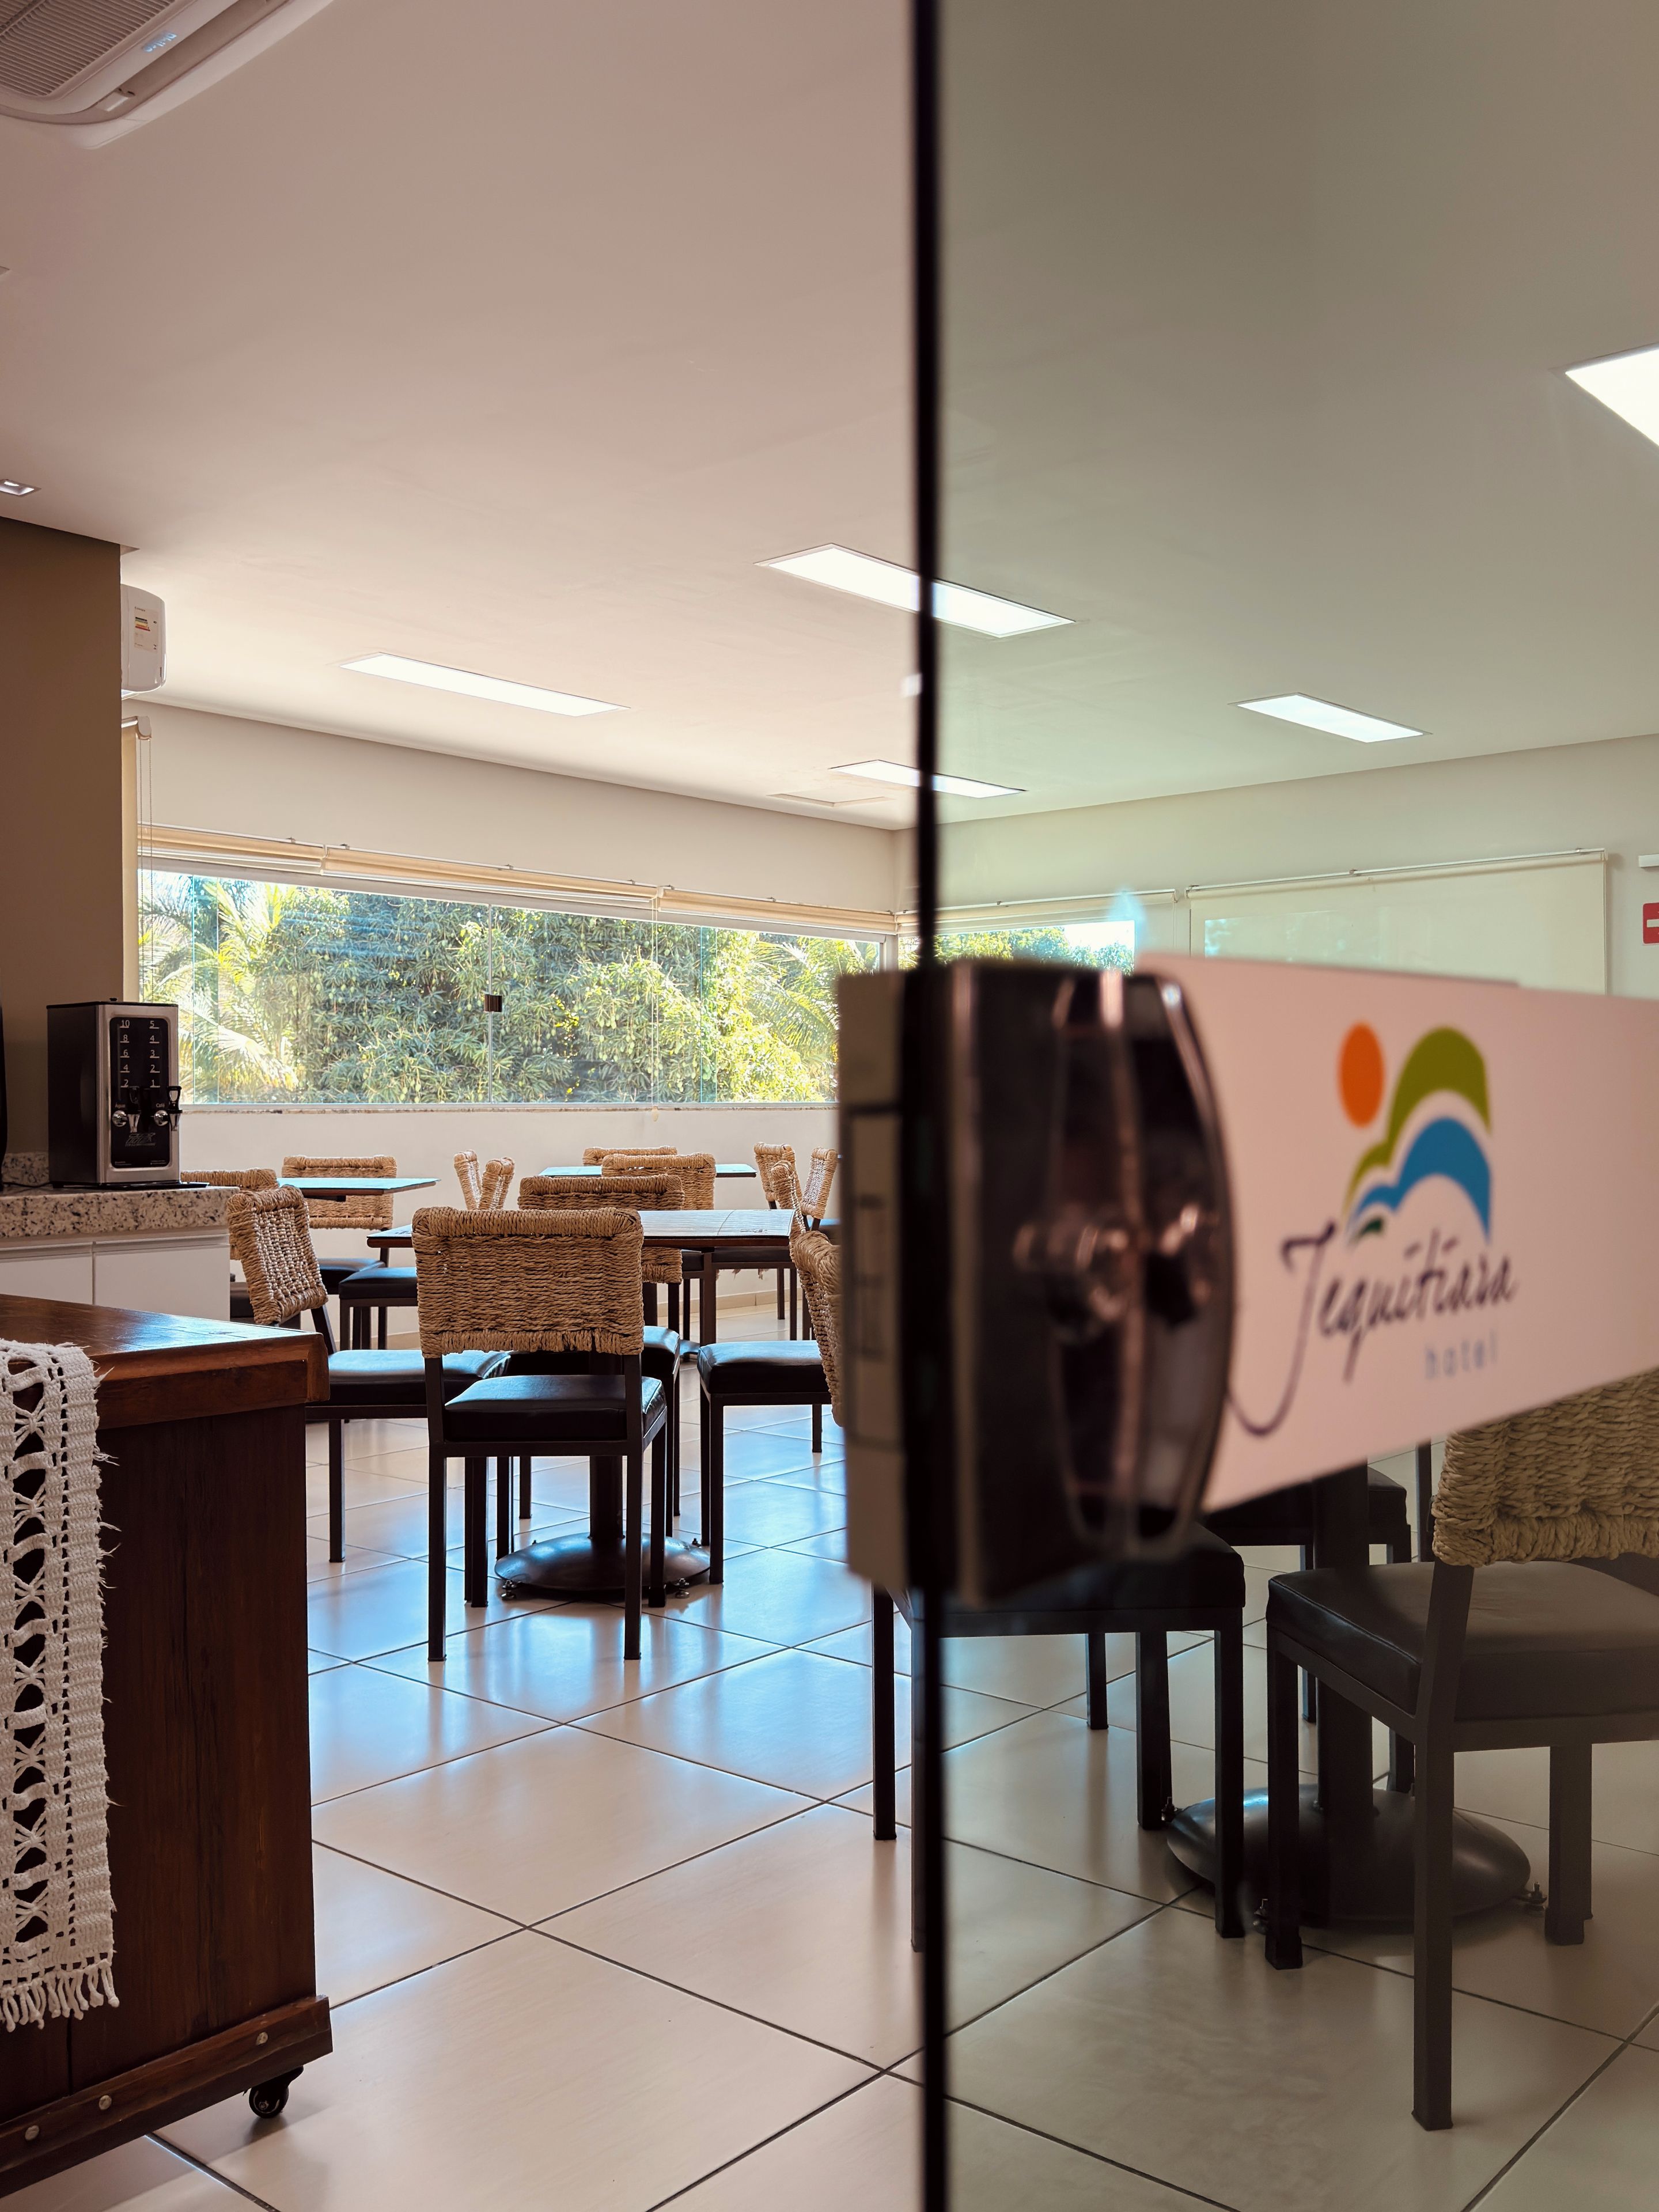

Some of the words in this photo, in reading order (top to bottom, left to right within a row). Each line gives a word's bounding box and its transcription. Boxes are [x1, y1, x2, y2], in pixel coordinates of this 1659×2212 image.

[121, 1020, 130, 1028] 10
[150, 1020, 155, 1028] 5
[123, 1049, 128, 1057] 6
[150, 1064, 155, 1072] 2
[124, 1079, 128, 1087] 2
[1425, 1328, 1498, 1380] hotel
